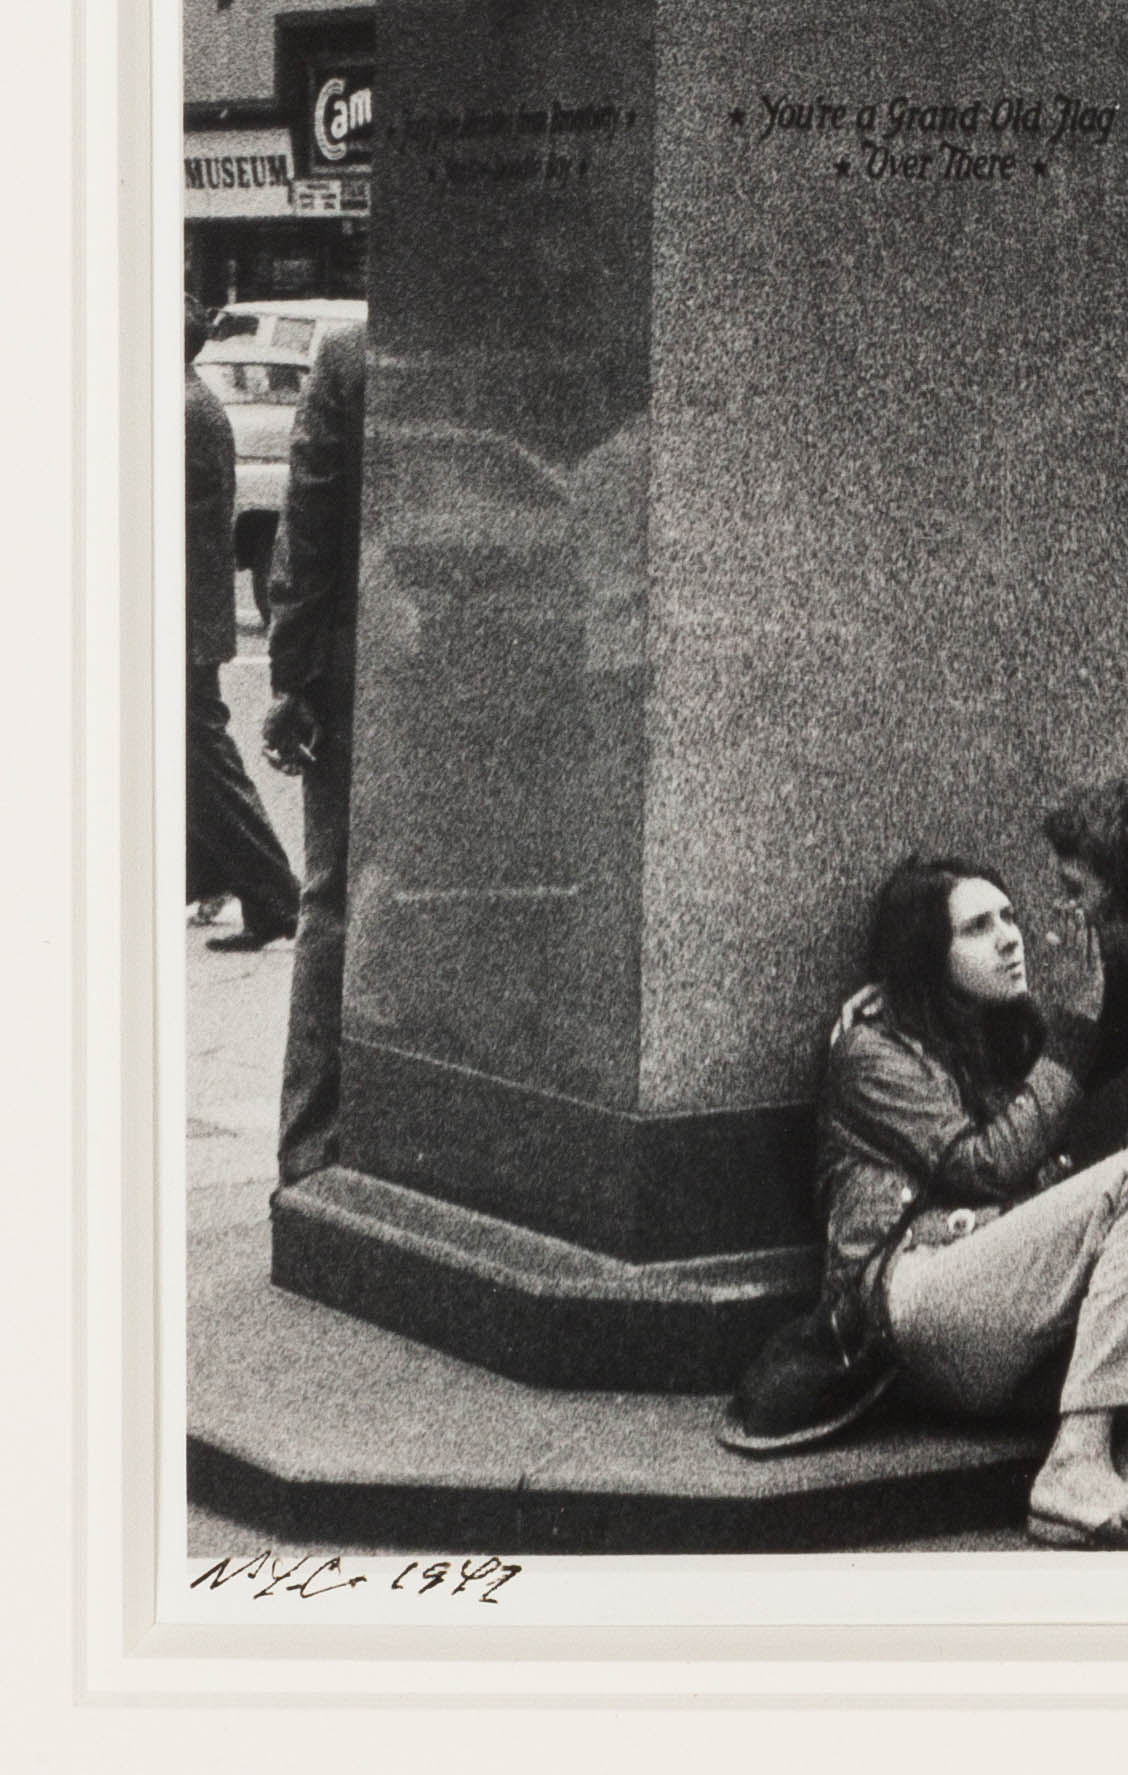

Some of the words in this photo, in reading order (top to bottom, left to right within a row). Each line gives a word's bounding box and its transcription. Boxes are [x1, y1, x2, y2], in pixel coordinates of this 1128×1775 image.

[758, 95, 845, 139] You're
[856, 106, 875, 130] a
[883, 95, 982, 140] Grand
[991, 98, 1042, 135] Old
[1048, 93, 1116, 145] Flag
[184, 155, 288, 190] MUSEUM
[861, 141, 932, 180] Over
[939, 141, 1017, 181] There
